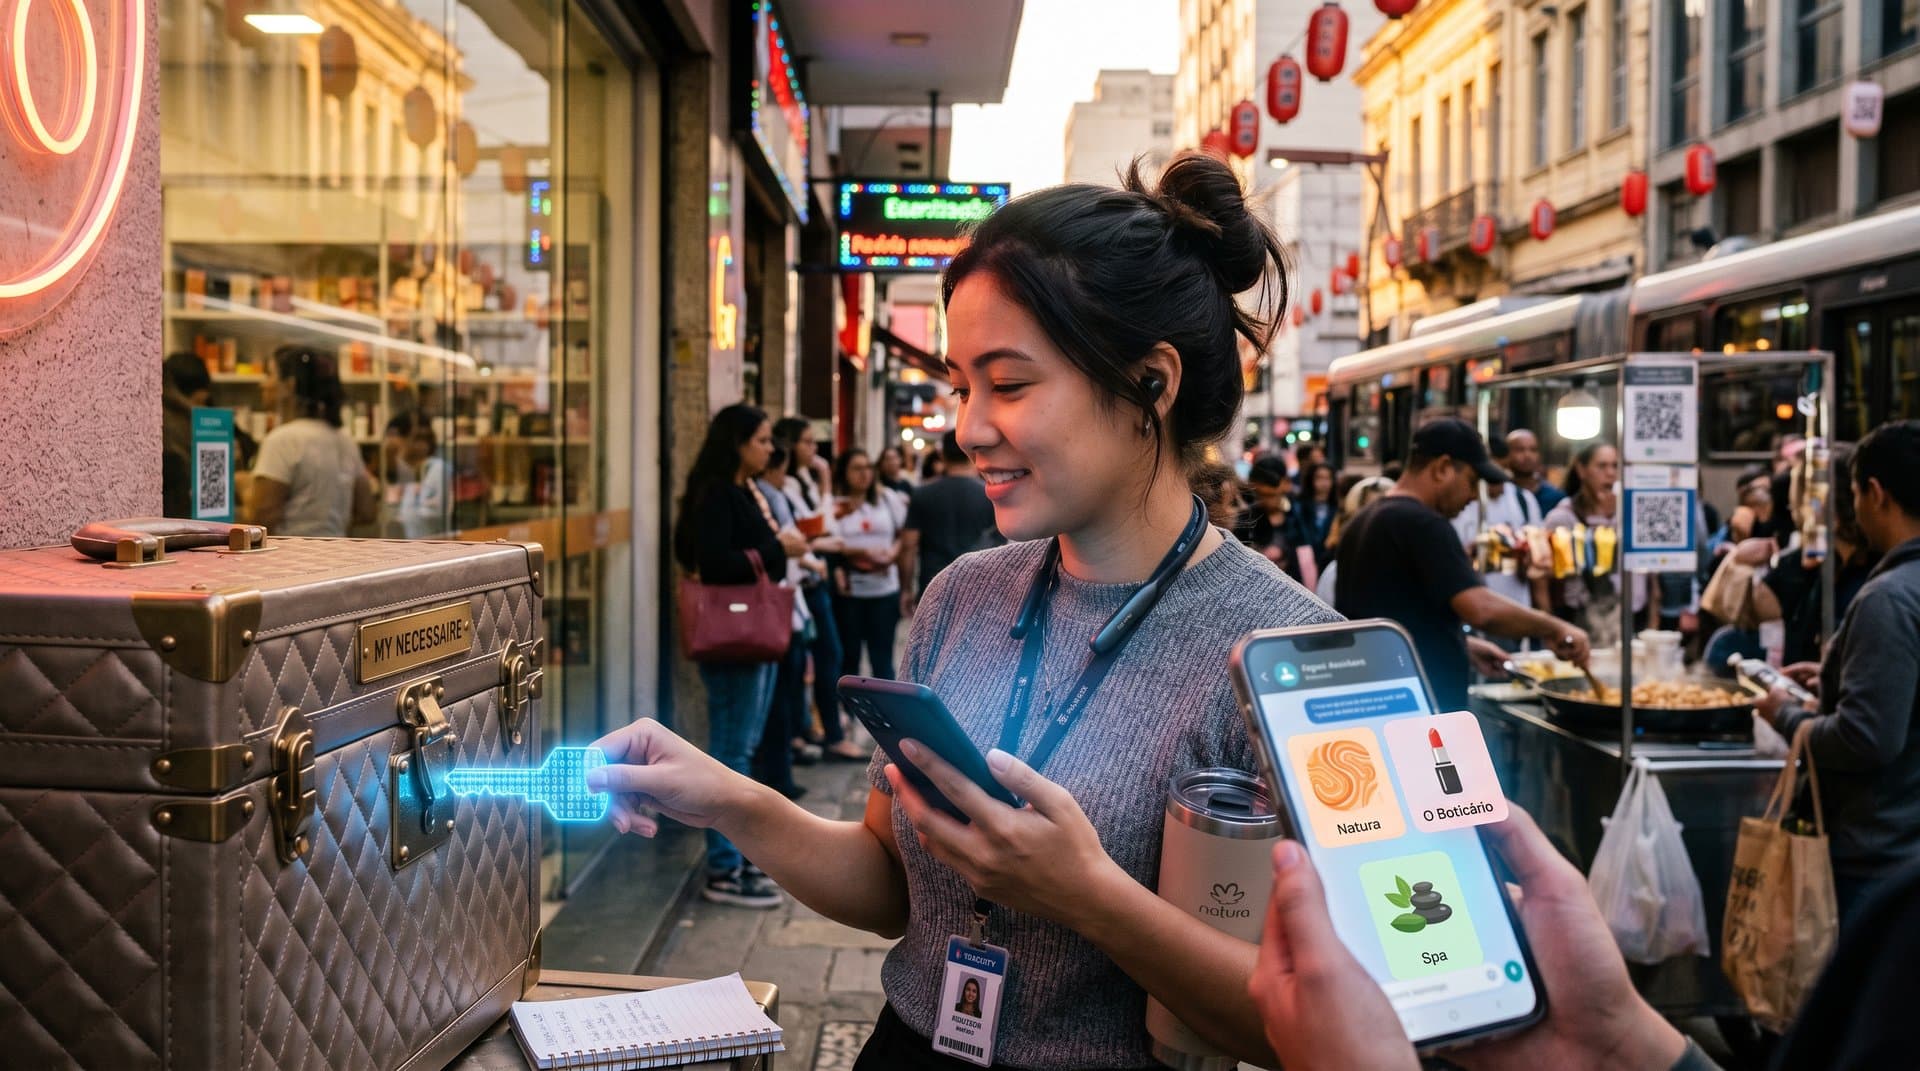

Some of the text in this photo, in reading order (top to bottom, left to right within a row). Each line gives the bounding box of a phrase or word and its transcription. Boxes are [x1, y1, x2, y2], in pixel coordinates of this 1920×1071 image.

[374, 619, 462, 663] MY NECESSAIRE
[1423, 801, 1494, 822] O Boticário
[1337, 820, 1381, 835] Natura
[1199, 904, 1250, 918] natura
[1421, 951, 1448, 966] Spa
